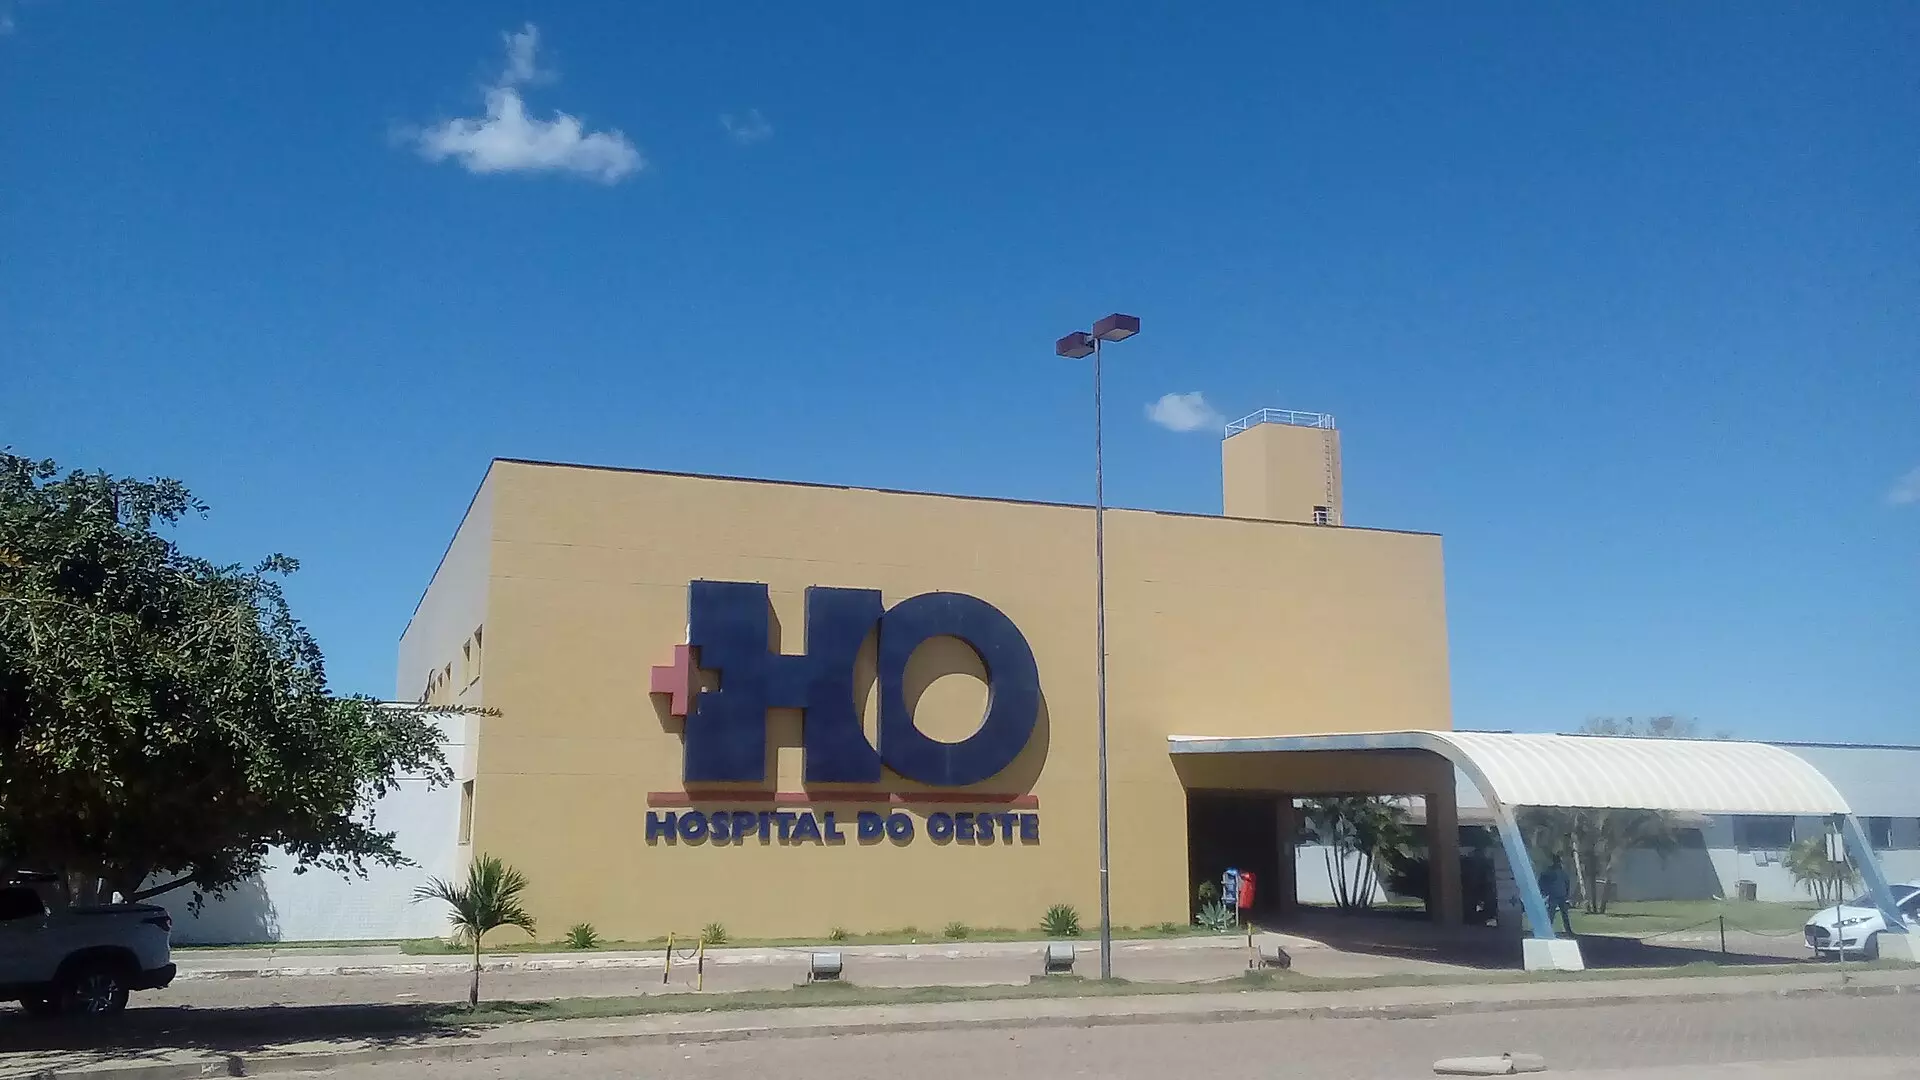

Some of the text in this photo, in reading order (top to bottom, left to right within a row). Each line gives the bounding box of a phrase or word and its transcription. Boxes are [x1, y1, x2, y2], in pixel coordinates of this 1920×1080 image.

[684, 580, 1039, 786] HO
[645, 811, 1040, 842] HOSPITAL DO OESTE
